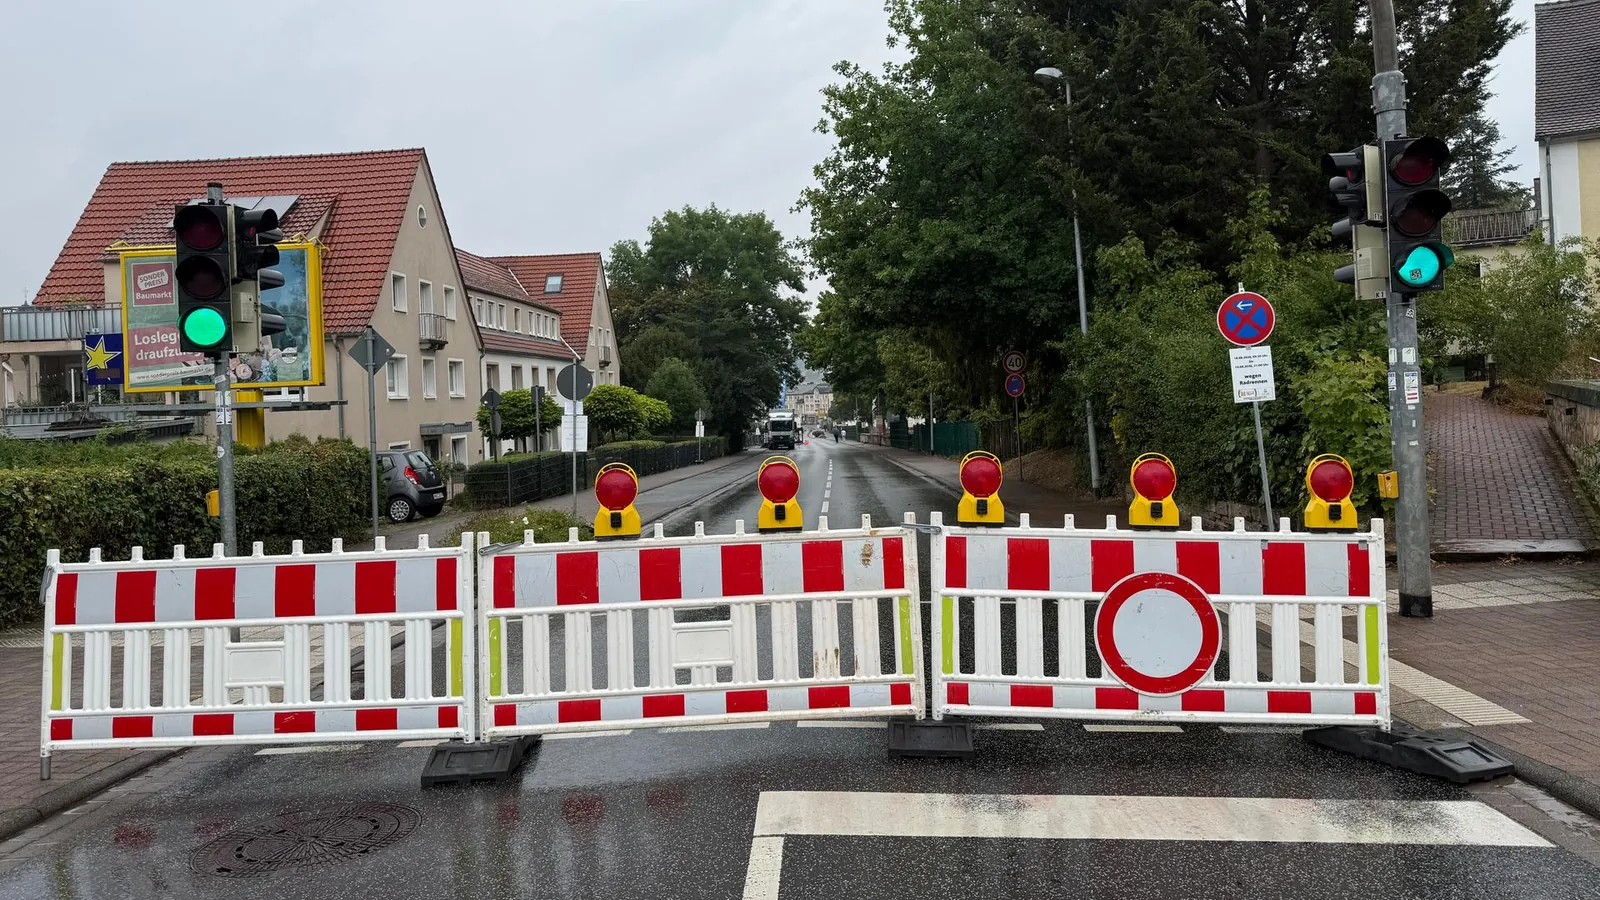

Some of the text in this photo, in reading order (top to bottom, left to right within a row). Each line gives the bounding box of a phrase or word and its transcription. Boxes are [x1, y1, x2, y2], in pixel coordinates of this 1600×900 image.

[139, 271, 165, 283] SONDER
[144, 278, 164, 288] PREIS!
[136, 291, 172, 300] Baumarkt
[134, 331, 180, 346] Losleg
[1008, 357, 1021, 367] 40
